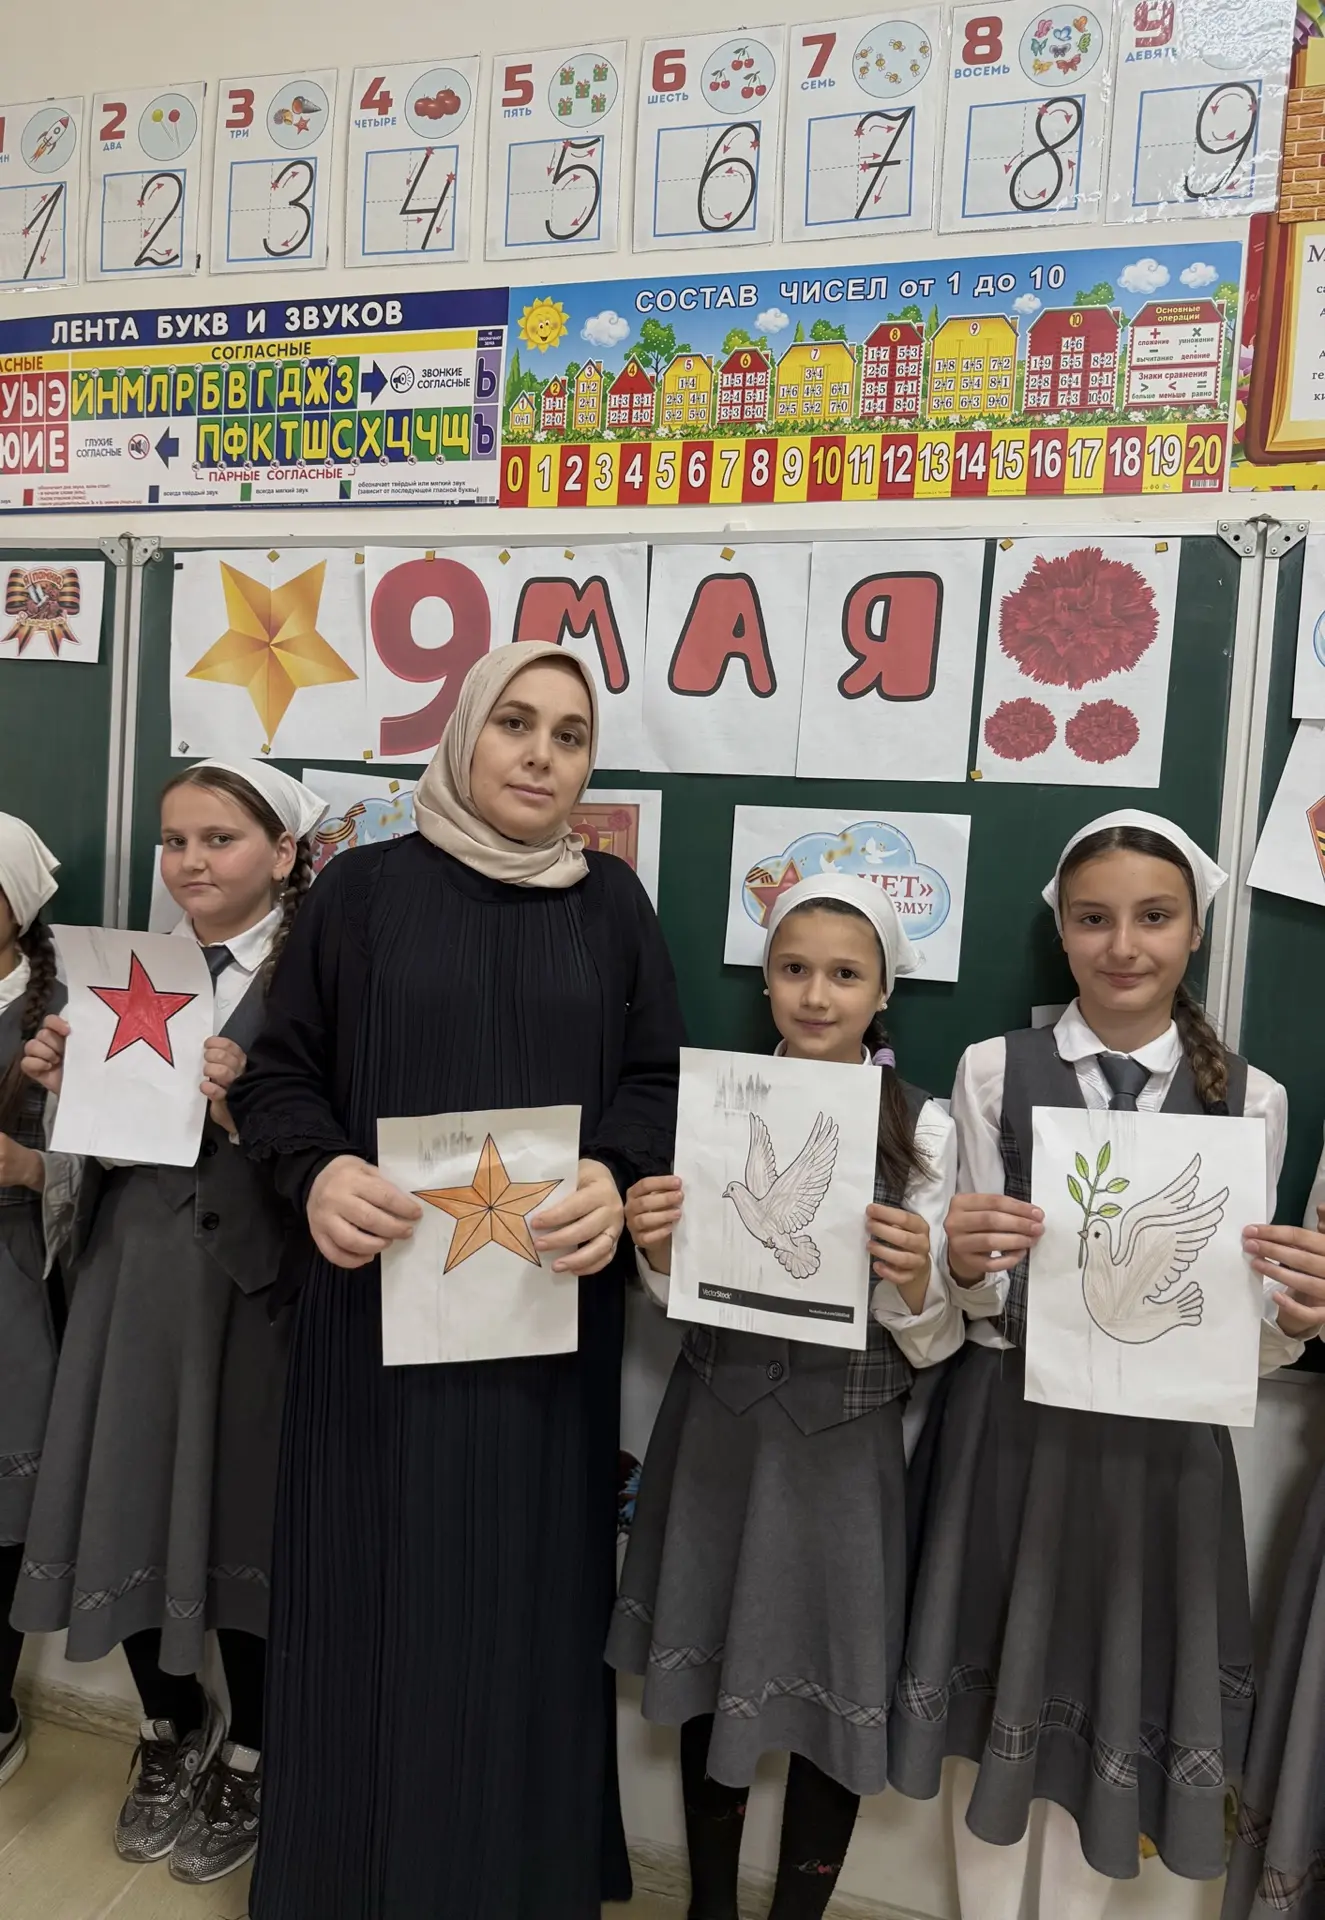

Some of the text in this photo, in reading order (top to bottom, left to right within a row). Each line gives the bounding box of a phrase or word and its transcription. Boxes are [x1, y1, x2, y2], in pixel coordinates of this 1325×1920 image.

[1133, 0, 1175, 47] 9
[961, 15, 1003, 66] 8
[801, 32, 837, 79] 7
[652, 48, 686, 93] 6
[953, 64, 1011, 79] ВОСЕМЬ
[502, 63, 534, 107] 5
[800, 78, 836, 92] СЕМЬ
[359, 76, 394, 116] 4
[647, 92, 689, 105] ШЕСТЬ
[225, 88, 255, 129] 3
[503, 107, 533, 119] ПЯТЬ
[100, 102, 127, 141] 2
[354, 116, 397, 129] ЧЕТЫРЕ
[229, 128, 250, 139] ТРИ
[102, 141, 123, 152] ДВА
[1184, 82, 1258, 199] 9
[1009, 97, 1083, 211] 8
[854, 105, 916, 220] 7
[698, 122, 760, 232] 6
[545, 137, 601, 240] 5
[399, 147, 456, 250] 4
[263, 159, 315, 257] 3
[134, 172, 183, 267] 2
[22, 184, 64, 279] 1
[635, 264, 1066, 314] СОСТАВ ЧИСЕЛ от 1 до 10
[1156, 306, 1201, 314] Основные
[51, 300, 403, 344] ЛЕНТА БУКВ И ЗВУКОВ
[1072, 314, 1081, 326] 10
[1157, 314, 1200, 323] операции
[892, 329, 898, 340] 8
[971, 323, 978, 334] 9
[1179, 337, 1214, 345] умножение
[211, 342, 312, 360] СОГЛАСНЫЕ
[812, 349, 818, 359] 7
[686, 360, 692, 370] 5
[743, 354, 749, 366] 6
[1136, 355, 1174, 363] вычитание
[421, 368, 463, 378] ЗВОНКИЕ
[587, 367, 592, 377] 3
[629, 364, 635, 375] 4
[1138, 370, 1208, 380] Знаки сравнения
[417, 378, 471, 389] СОГЛАСНЫЕ
[552, 383, 558, 393] 2
[520, 399, 525, 409] 1
[85, 438, 113, 447] ГЛУХИЕ
[76, 448, 122, 458] СОГЛАСНЫЕ
[506, 434, 1223, 492] 0 1 2 3 4 5 6 7 8 9 10 11 12 13 14 15 16 17 18 19 20
[209, 467, 343, 482] ПАРНЫЕ СОГЛАСНЫЕ
[370, 558, 491, 757] 9
[893, 902, 933, 915] ЗМУ!
